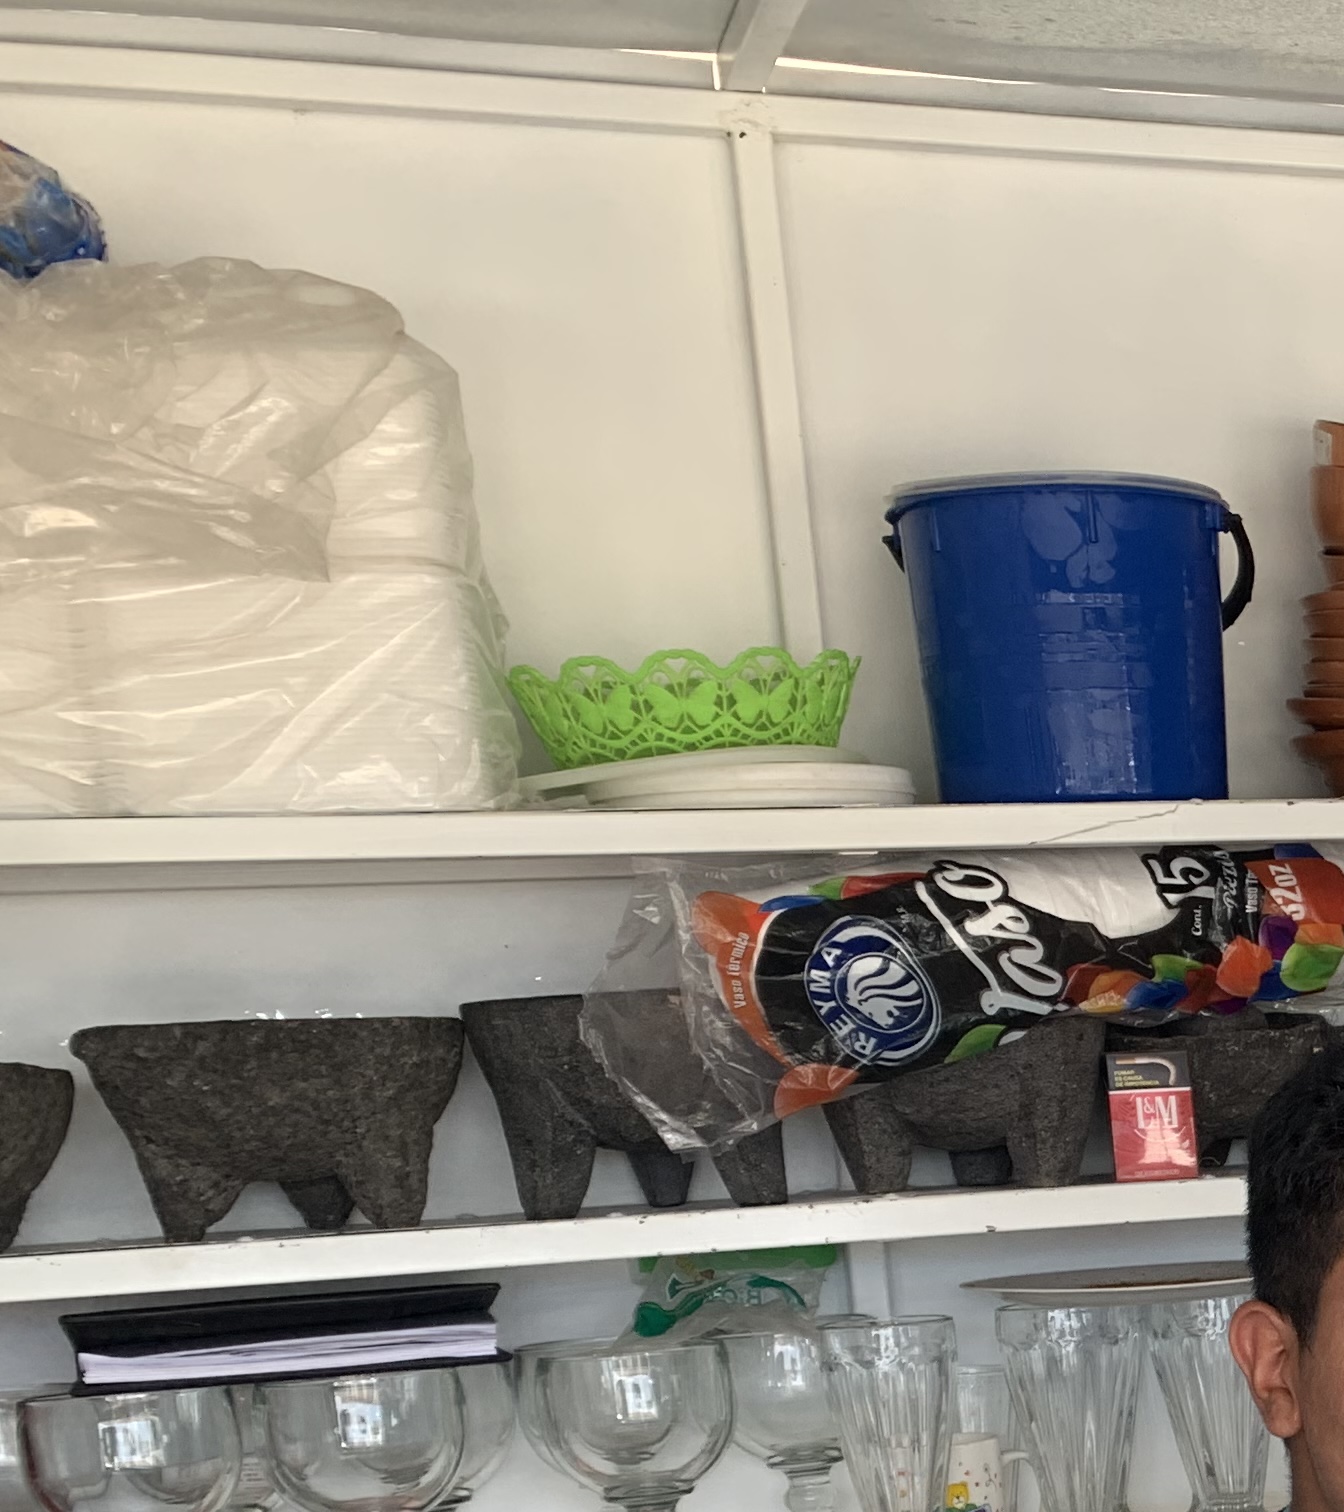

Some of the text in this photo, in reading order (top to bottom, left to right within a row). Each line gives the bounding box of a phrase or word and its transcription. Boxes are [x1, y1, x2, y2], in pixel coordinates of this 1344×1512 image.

[1150, 855, 1216, 908] 15
[732, 982, 746, 1009] Vaso
[809, 945, 877, 1055] REYMA
[1135, 1095, 1179, 1129] L&M
